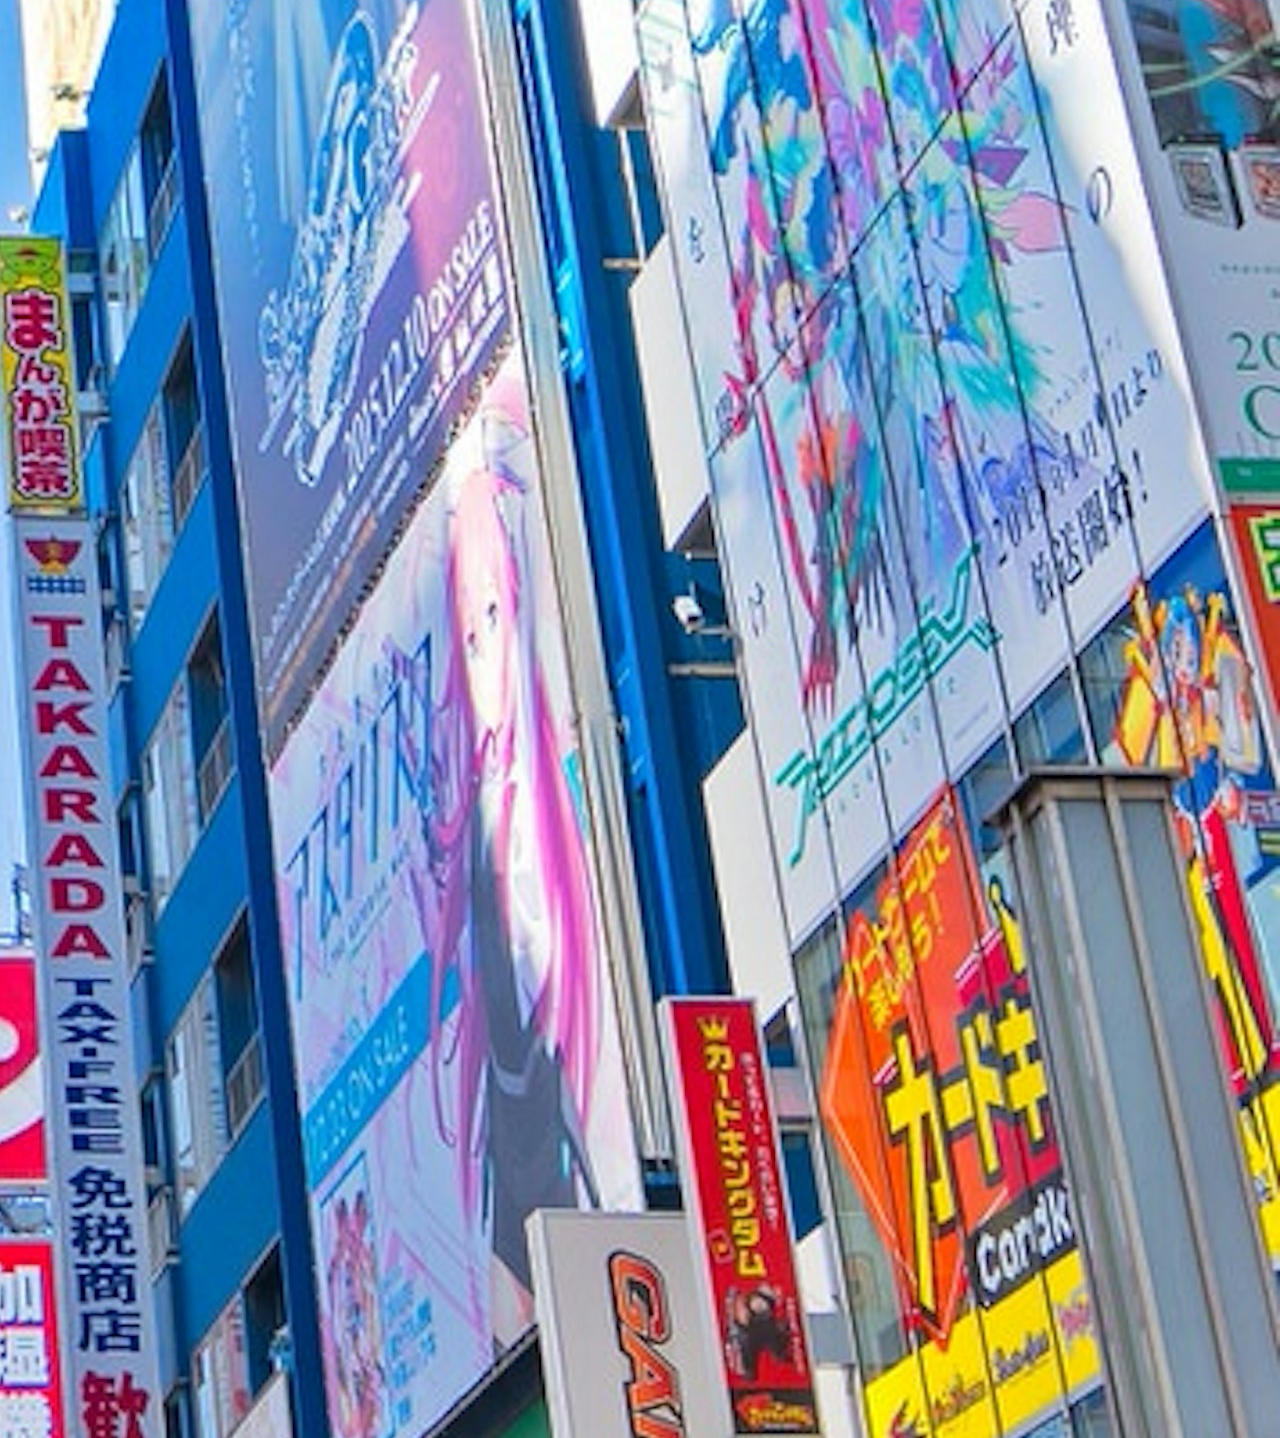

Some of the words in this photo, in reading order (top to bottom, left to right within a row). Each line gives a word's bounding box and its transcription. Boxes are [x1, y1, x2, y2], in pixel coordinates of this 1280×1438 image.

[4, 288, 70, 500] まんが喫茶
[30, 614, 111, 961] TAKARADA
[66, 1165, 143, 1354] 免税商店
[701, 1044, 768, 1278] カードキングダム
